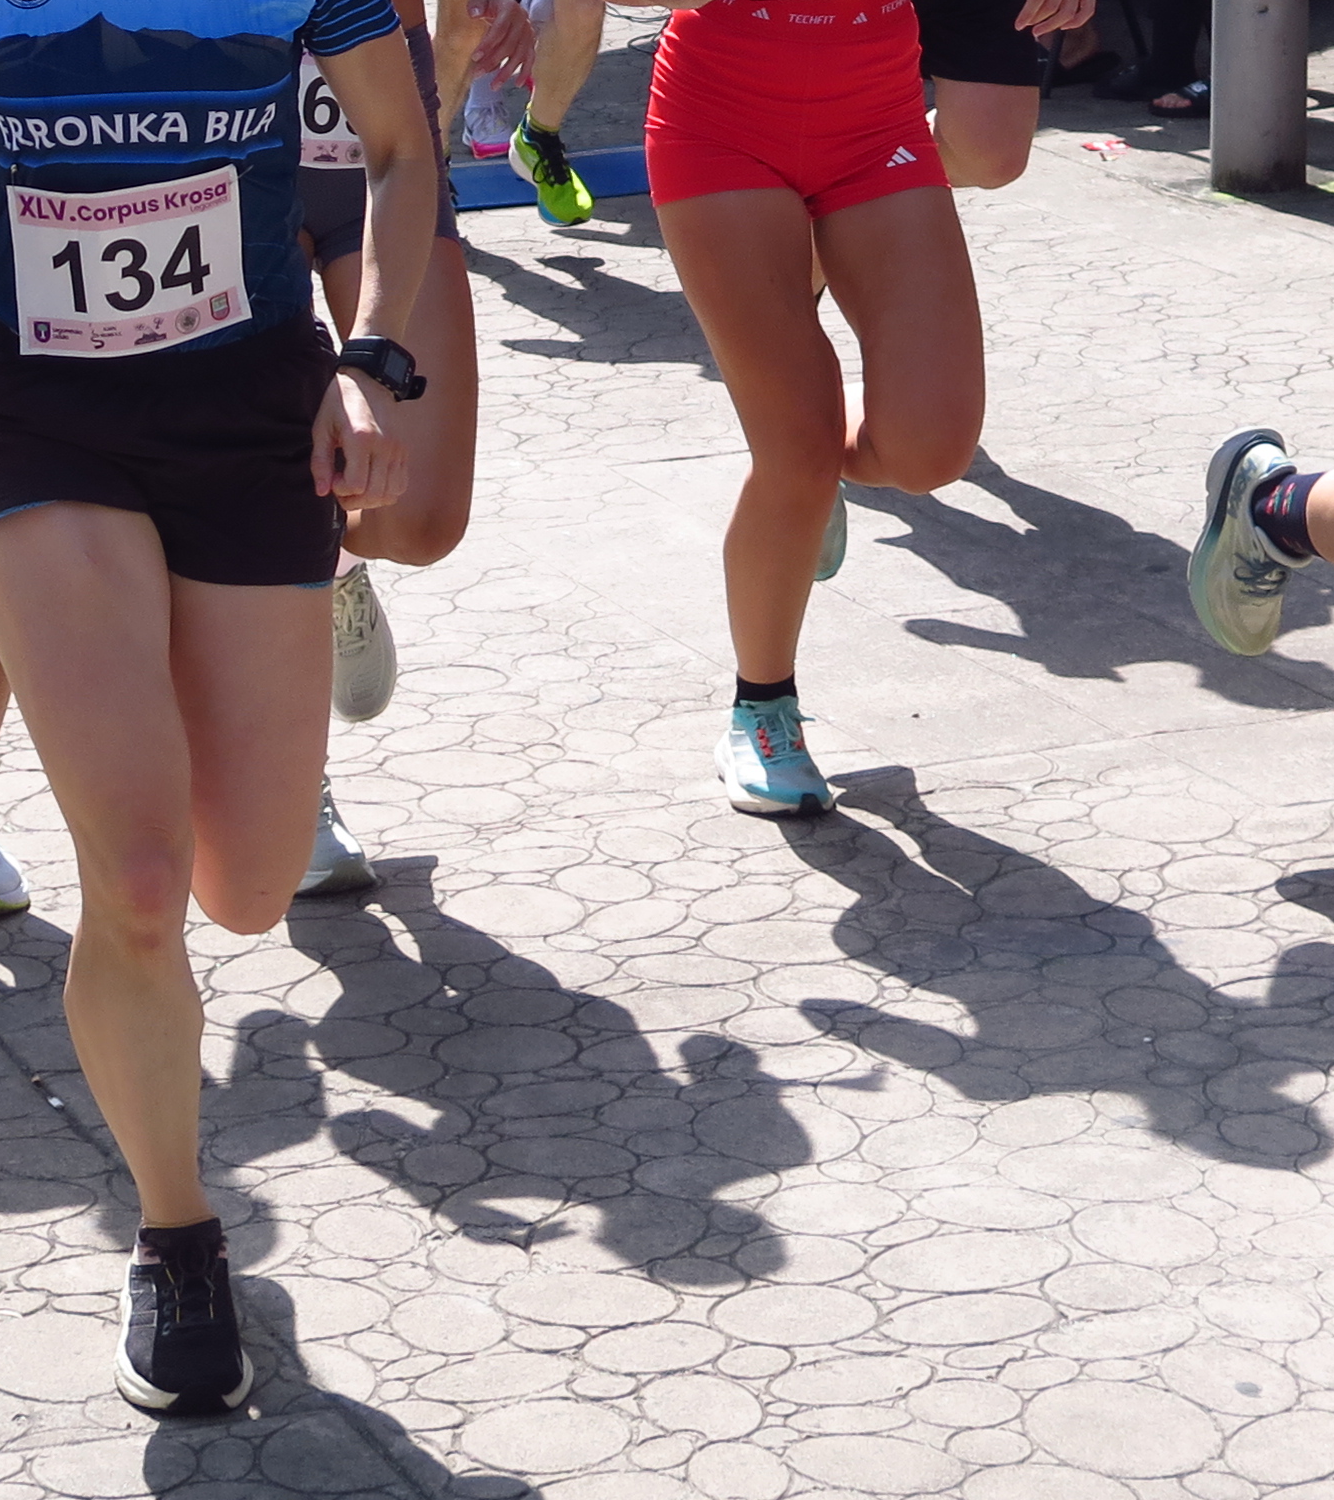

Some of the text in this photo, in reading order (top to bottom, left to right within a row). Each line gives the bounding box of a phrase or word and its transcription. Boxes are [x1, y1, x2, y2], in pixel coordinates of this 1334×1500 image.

[789, 13, 836, 25] TECHFIT
[204, 101, 277, 145] BILA
[164, 181, 228, 210] Krosa
[52, 224, 211, 314] 134
